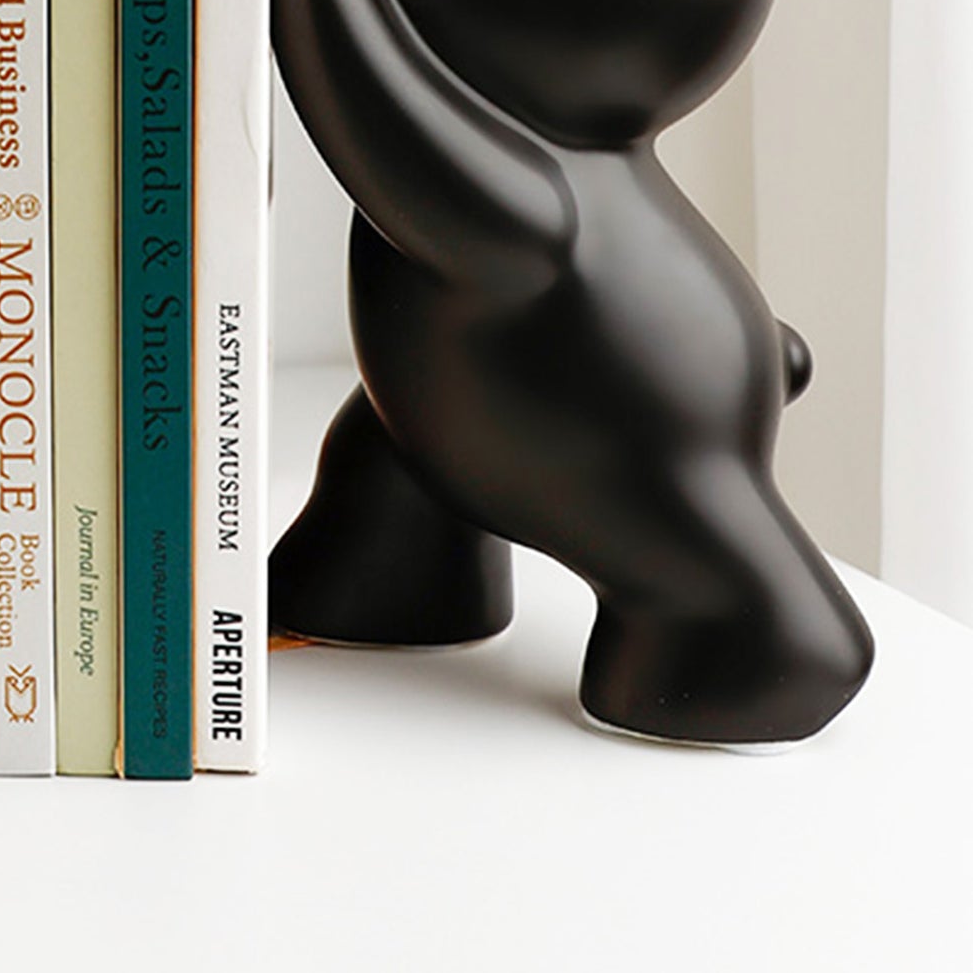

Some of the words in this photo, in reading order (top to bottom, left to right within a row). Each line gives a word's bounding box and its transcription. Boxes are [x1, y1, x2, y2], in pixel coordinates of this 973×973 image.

[142, 237, 181, 271] &
[143, 294, 182, 450] Snacks
[220, 305, 240, 428] EASTMAN
[219, 437, 239, 550] MUSEUM
[20, 535, 40, 590] Book
[75, 506, 99, 579] Journal
[151, 529, 168, 623] NATURALLY
[80, 584, 98, 601] in
[74, 607, 98, 676] Europe
[151, 624, 168, 665] FAST
[213, 611, 242, 740] APERTURE
[150, 668, 168, 740] RECIPES
